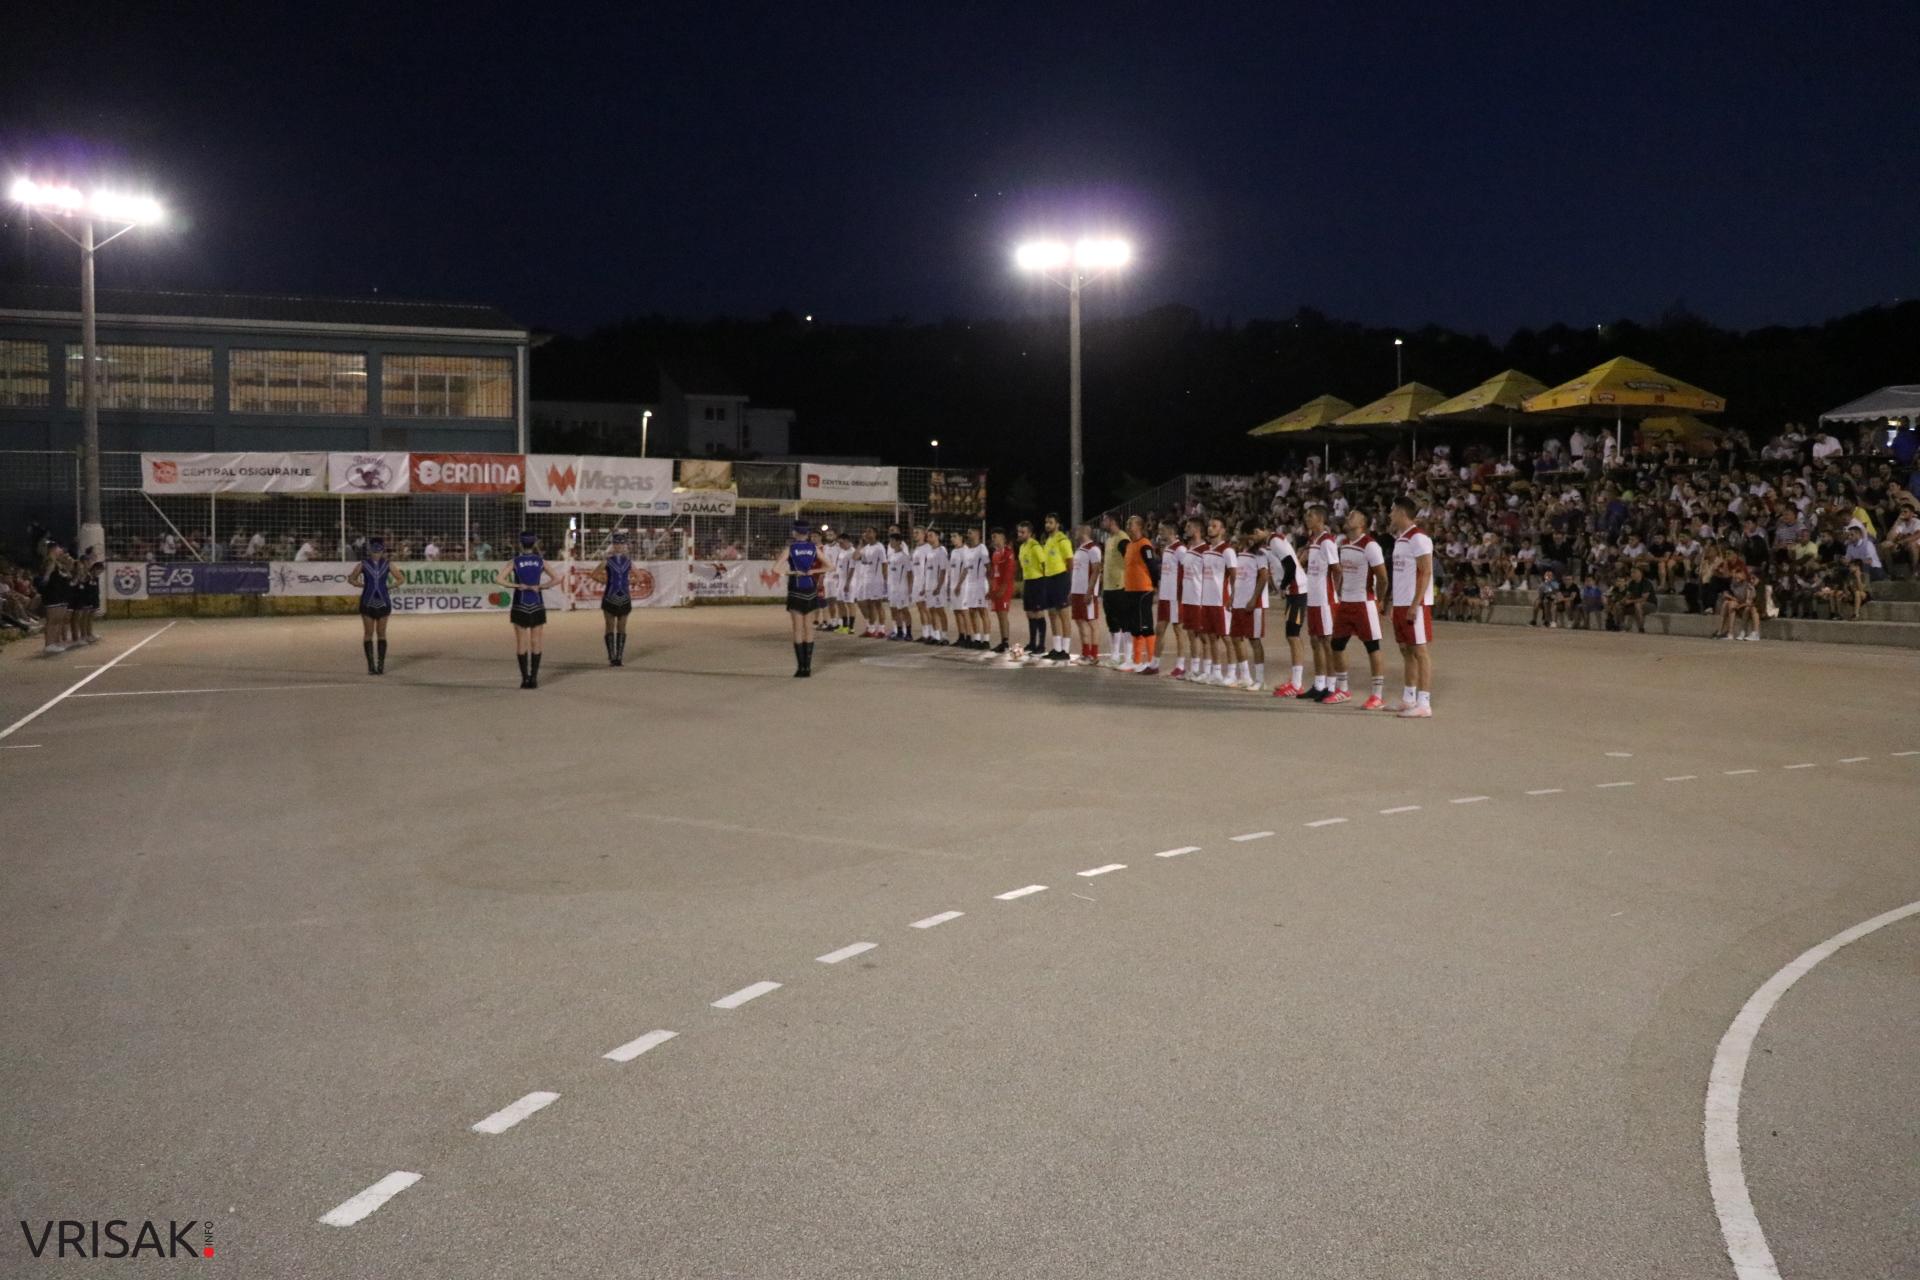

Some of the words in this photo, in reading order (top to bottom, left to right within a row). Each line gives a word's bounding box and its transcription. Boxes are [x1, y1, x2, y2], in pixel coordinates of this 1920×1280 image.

[182, 467, 236, 477] CENTRAL
[238, 467, 312, 476] OSIGURANJE
[415, 460, 521, 484] BERNINA
[580, 470, 654, 496] Mepas
[297, 574, 347, 584] SAPO
